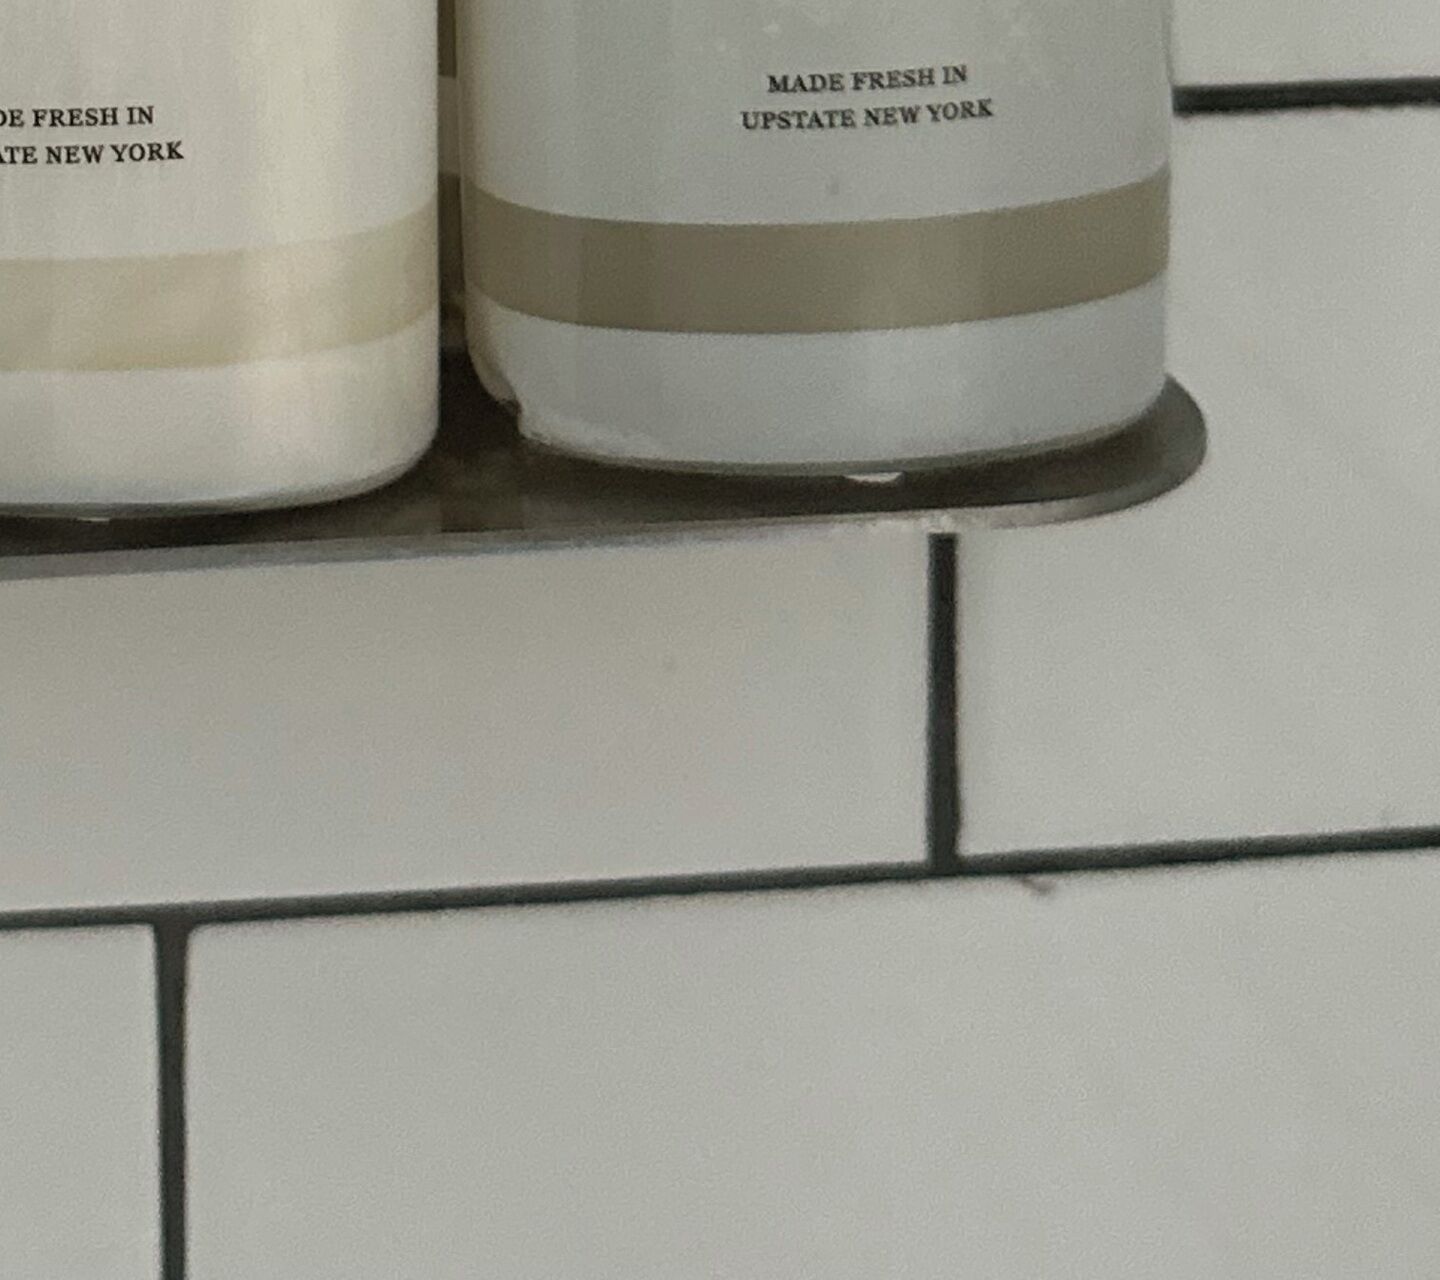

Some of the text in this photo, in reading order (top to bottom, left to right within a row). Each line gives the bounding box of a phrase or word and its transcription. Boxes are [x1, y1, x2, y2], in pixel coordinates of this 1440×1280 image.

[767, 64, 969, 94] MADE FRESH IN
[31, 106, 120, 129] FRESH
[125, 104, 155, 127] IN
[739, 97, 995, 131] UPSTATE NEW YORK
[44, 143, 106, 166] NEW
[108, 139, 185, 164] YORK
